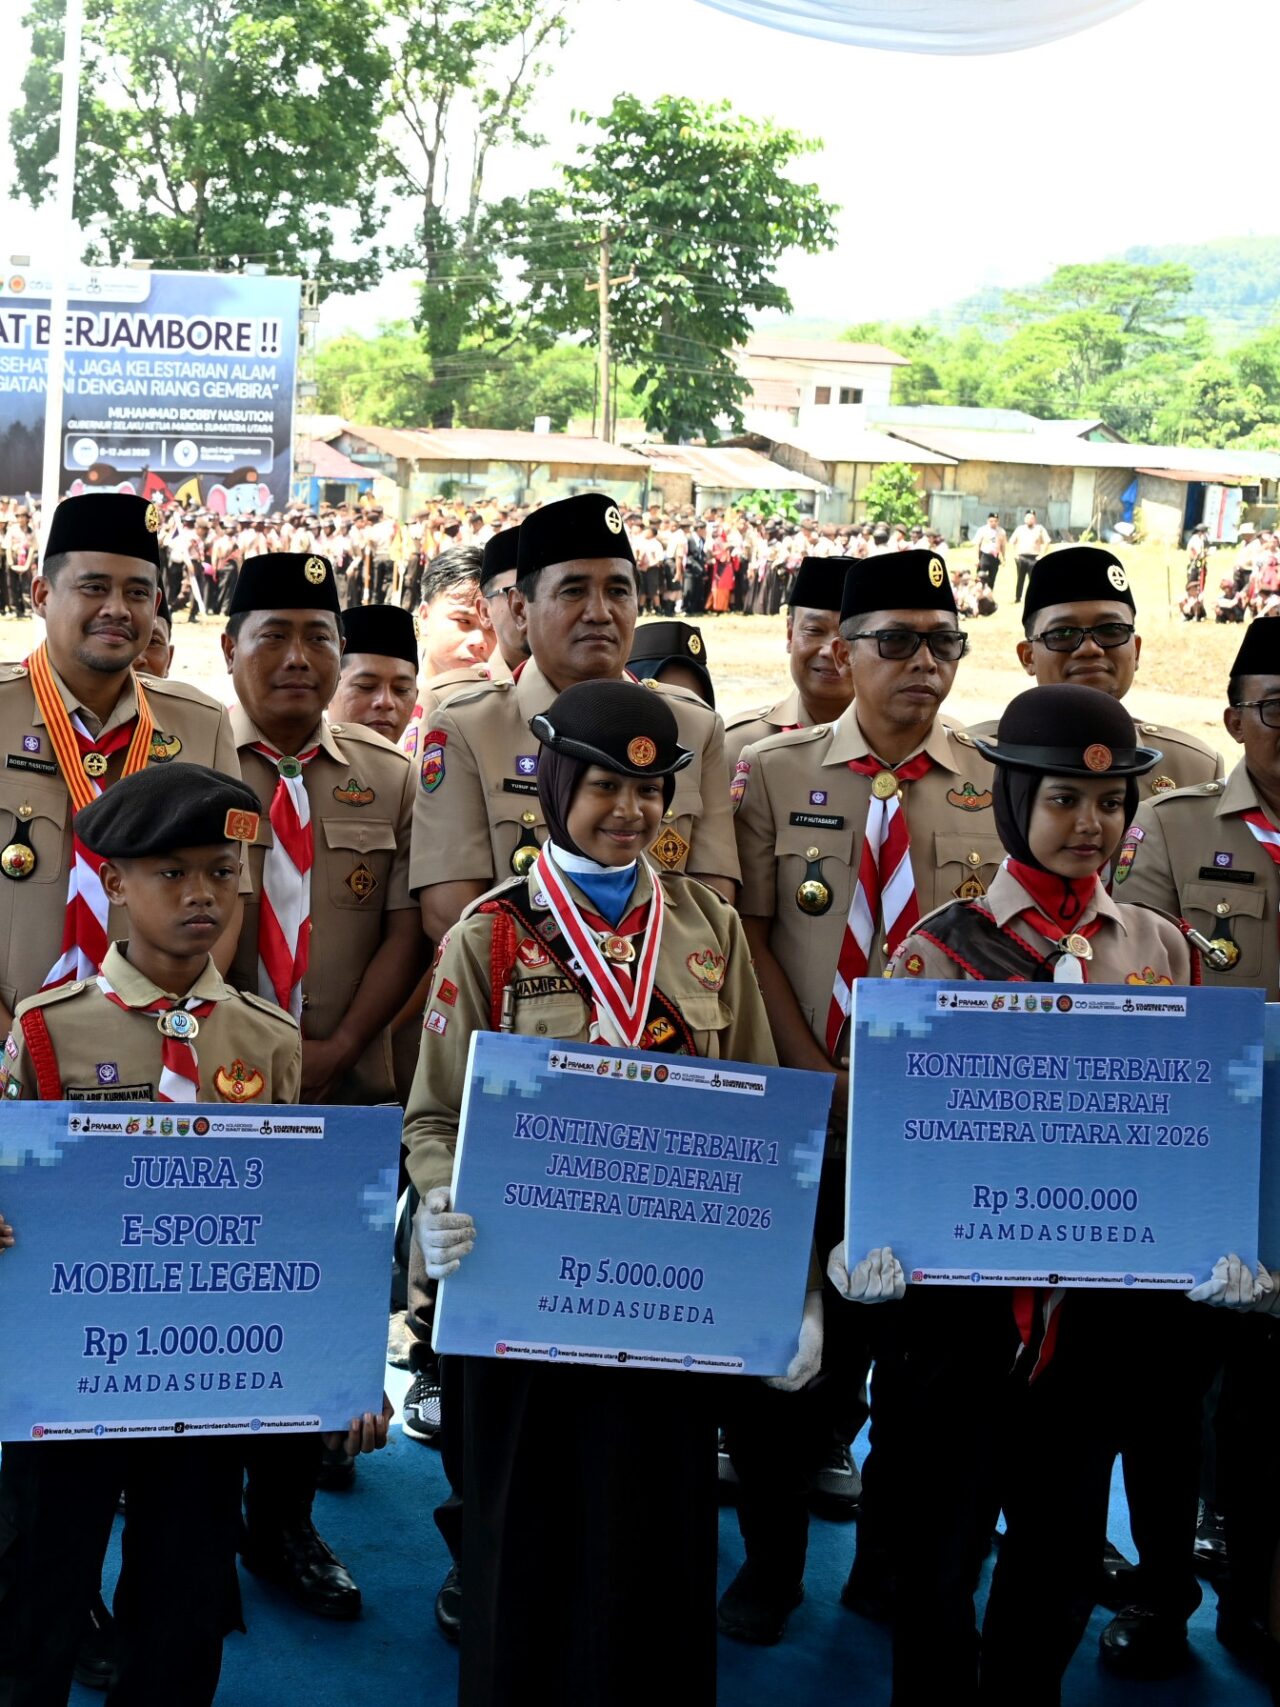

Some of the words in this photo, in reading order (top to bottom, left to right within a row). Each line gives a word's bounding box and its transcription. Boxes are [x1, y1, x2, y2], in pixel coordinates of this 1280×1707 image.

[80, 359, 122, 376] JAGA
[126, 360, 228, 379] KELESTARIAN
[231, 365, 276, 381] ALAM
[78, 378, 147, 397] DENGAN
[150, 380, 200, 397] RIANG
[108, 407, 178, 420] MUHAMMAD
[180, 408, 217, 421] BOBBY
[218, 409, 274, 422] NASUTION
[809, 816, 838, 826] HUTABARAT
[906, 1052, 1070, 1081] KONTINGEN
[1073, 1056, 1191, 1084] TERBAIK
[1195, 1059, 1212, 1084] 2
[946, 1088, 1063, 1112] JAMBORE
[1066, 1091, 1170, 1115] DAERAH
[91, 1122, 122, 1130] PRAMUKA
[513, 1112, 661, 1153] KONTINGEN
[664, 1129, 763, 1165] TERBAIK
[767, 1141, 780, 1166] 1
[904, 1119, 1036, 1145] SUMATERA
[1040, 1123, 1122, 1146] UTARA
[1126, 1125, 1152, 1147] XI
[1156, 1126, 1210, 1148] 2026
[124, 1156, 237, 1190] JUARA
[244, 1157, 264, 1188] 3
[546, 1154, 650, 1184] JAMBORE
[652, 1165, 742, 1195] DAERAH
[503, 1183, 622, 1216] SUMATERA
[626, 1196, 697, 1225] UTARA
[699, 1202, 722, 1226] XI
[725, 1205, 772, 1231] 2026
[972, 1185, 1008, 1215] Rp
[1014, 1186, 1138, 1212] 3.000.000
[121, 1214, 262, 1247] E-SPORT
[953, 1223, 1156, 1244] #JAMDASUBEDA
[50, 1261, 183, 1295] MOBILE
[188, 1260, 321, 1293] LEGEND
[558, 1255, 591, 1290] Rp
[595, 1258, 705, 1292] 5.000.000
[537, 1295, 716, 1325] #JAMDASUBEDA
[83, 1325, 128, 1365] Rp
[135, 1323, 284, 1357] 1.000.000
[76, 1371, 285, 1395] #JAMDASUBEDA
